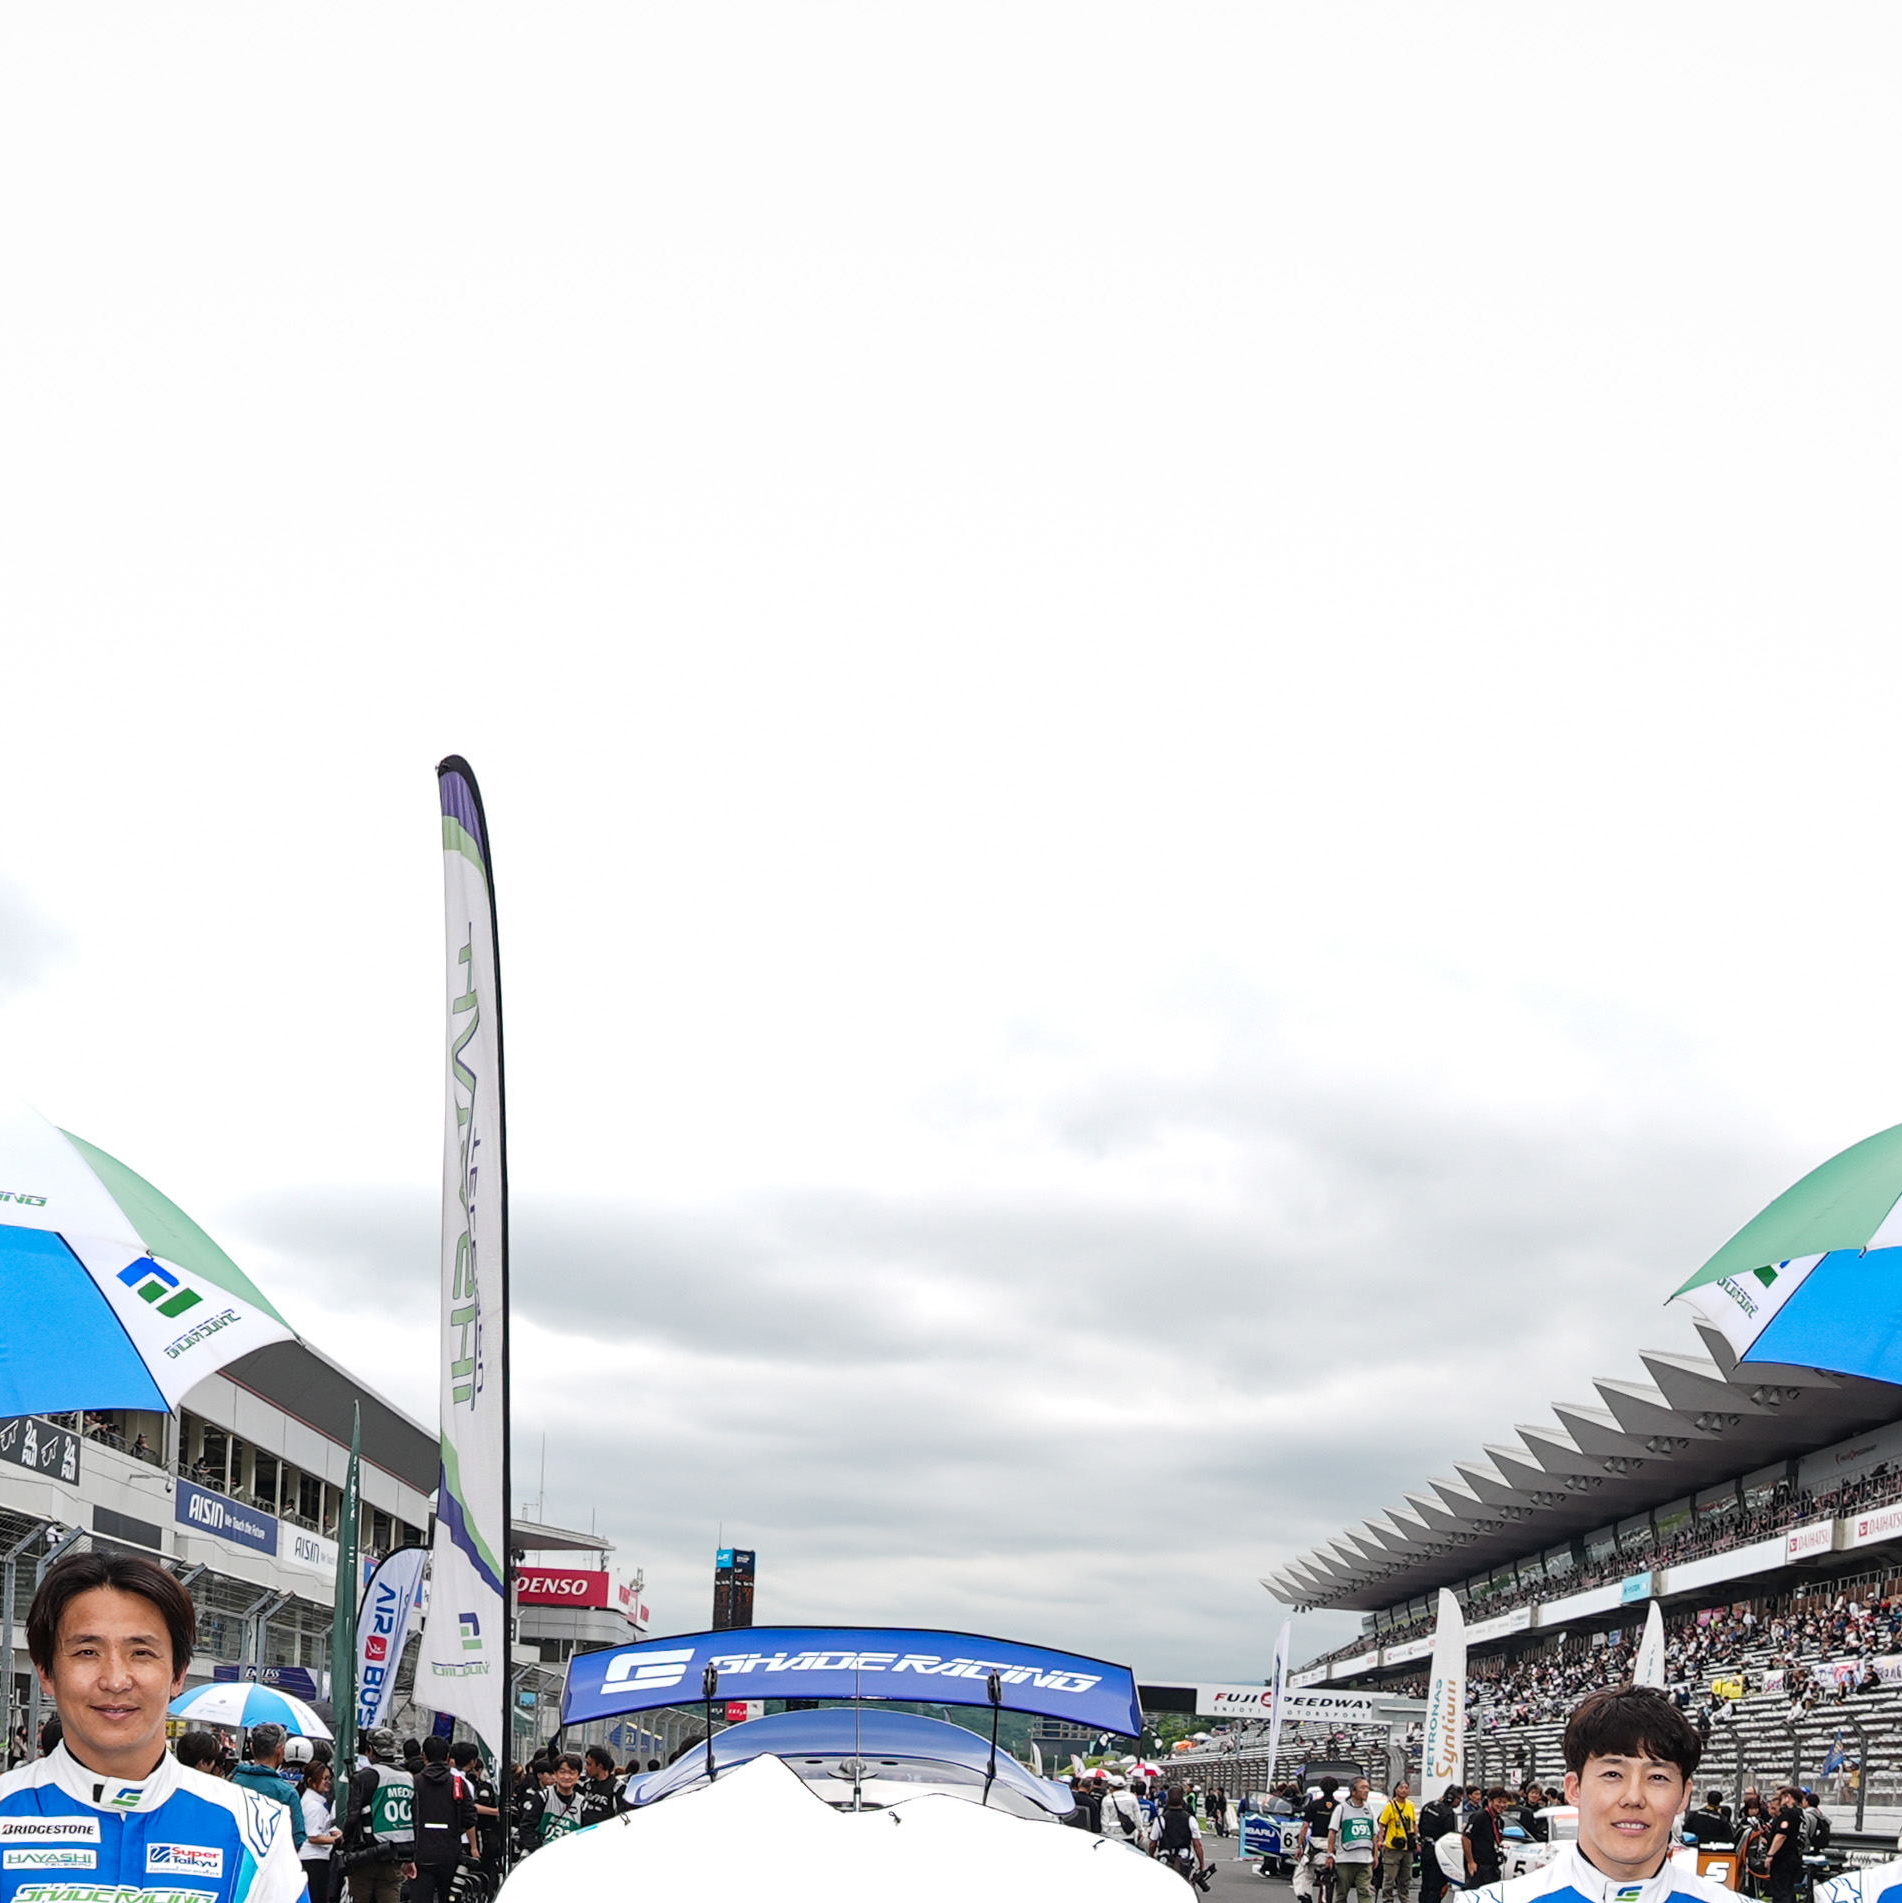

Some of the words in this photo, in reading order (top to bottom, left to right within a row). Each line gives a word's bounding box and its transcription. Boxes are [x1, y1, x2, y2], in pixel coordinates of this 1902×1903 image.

[189, 1494, 224, 1529] AISIN
[1798, 1527, 1831, 1550] DAIHATSU
[295, 1536, 319, 1565] AISIN
[516, 1577, 588, 1596] DENSO
[703, 1651, 883, 1676] SHADE
[889, 1656, 1102, 1694] RACING
[1214, 1693, 1256, 1706] FUJI
[1427, 1678, 1443, 1778] PETRONAS
[1436, 1679, 1456, 1779] Syntium
[1, 1823, 95, 1837] BRIDGESTONE
[7, 1853, 93, 1864] HAYASHI
[171, 1856, 218, 1868] Taikyu
[172, 1846, 220, 1859] Super
